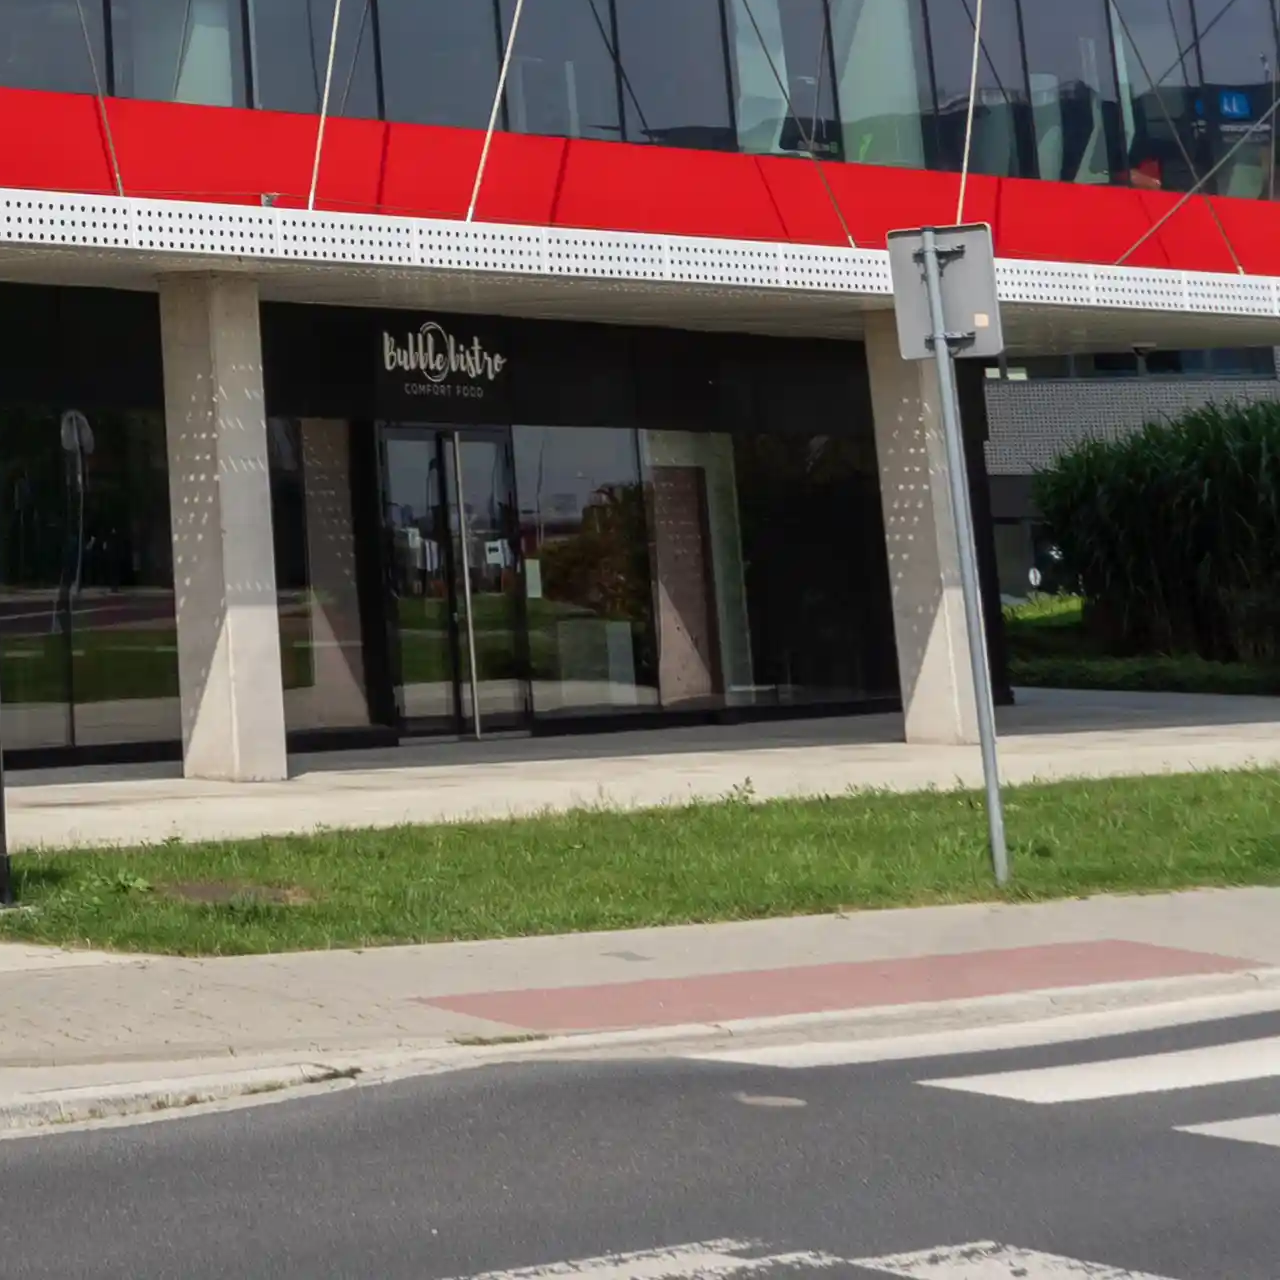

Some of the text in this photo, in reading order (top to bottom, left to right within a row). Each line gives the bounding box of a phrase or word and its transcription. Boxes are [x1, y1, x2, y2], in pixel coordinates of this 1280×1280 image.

[383, 331, 507, 381] Bubble bistro
[404, 383, 484, 398] COMFORT FOOD
